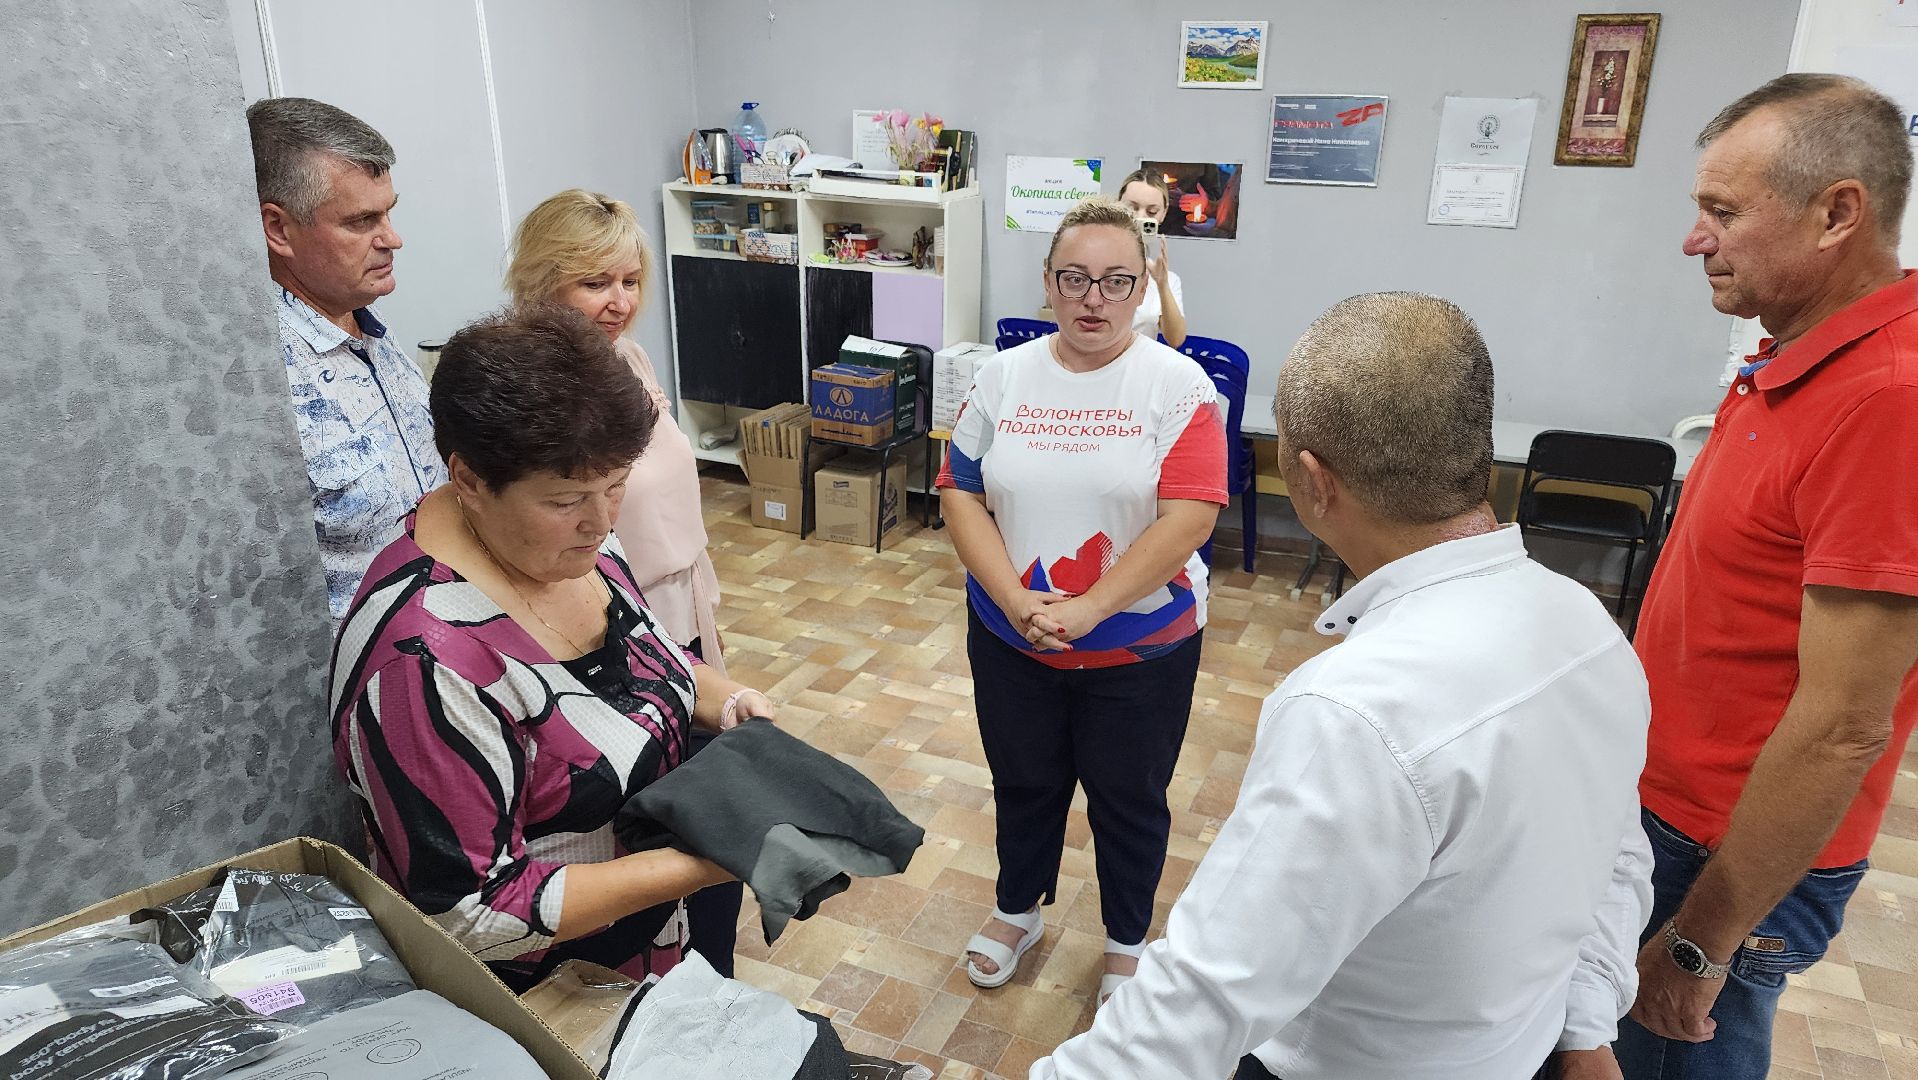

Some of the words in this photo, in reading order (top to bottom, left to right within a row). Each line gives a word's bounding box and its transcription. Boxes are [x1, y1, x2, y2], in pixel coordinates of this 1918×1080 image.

[1011, 185, 1062, 200] Окопная
[815, 404, 870, 423] ЛАДОГА
[1016, 404, 1134, 422] ВОЛОНТЕРЫ
[998, 419, 1143, 437] ПОДМОСКОВЬЯ
[1027, 440, 1051, 451] МЫ
[1053, 442, 1100, 453] РЯДОМ
